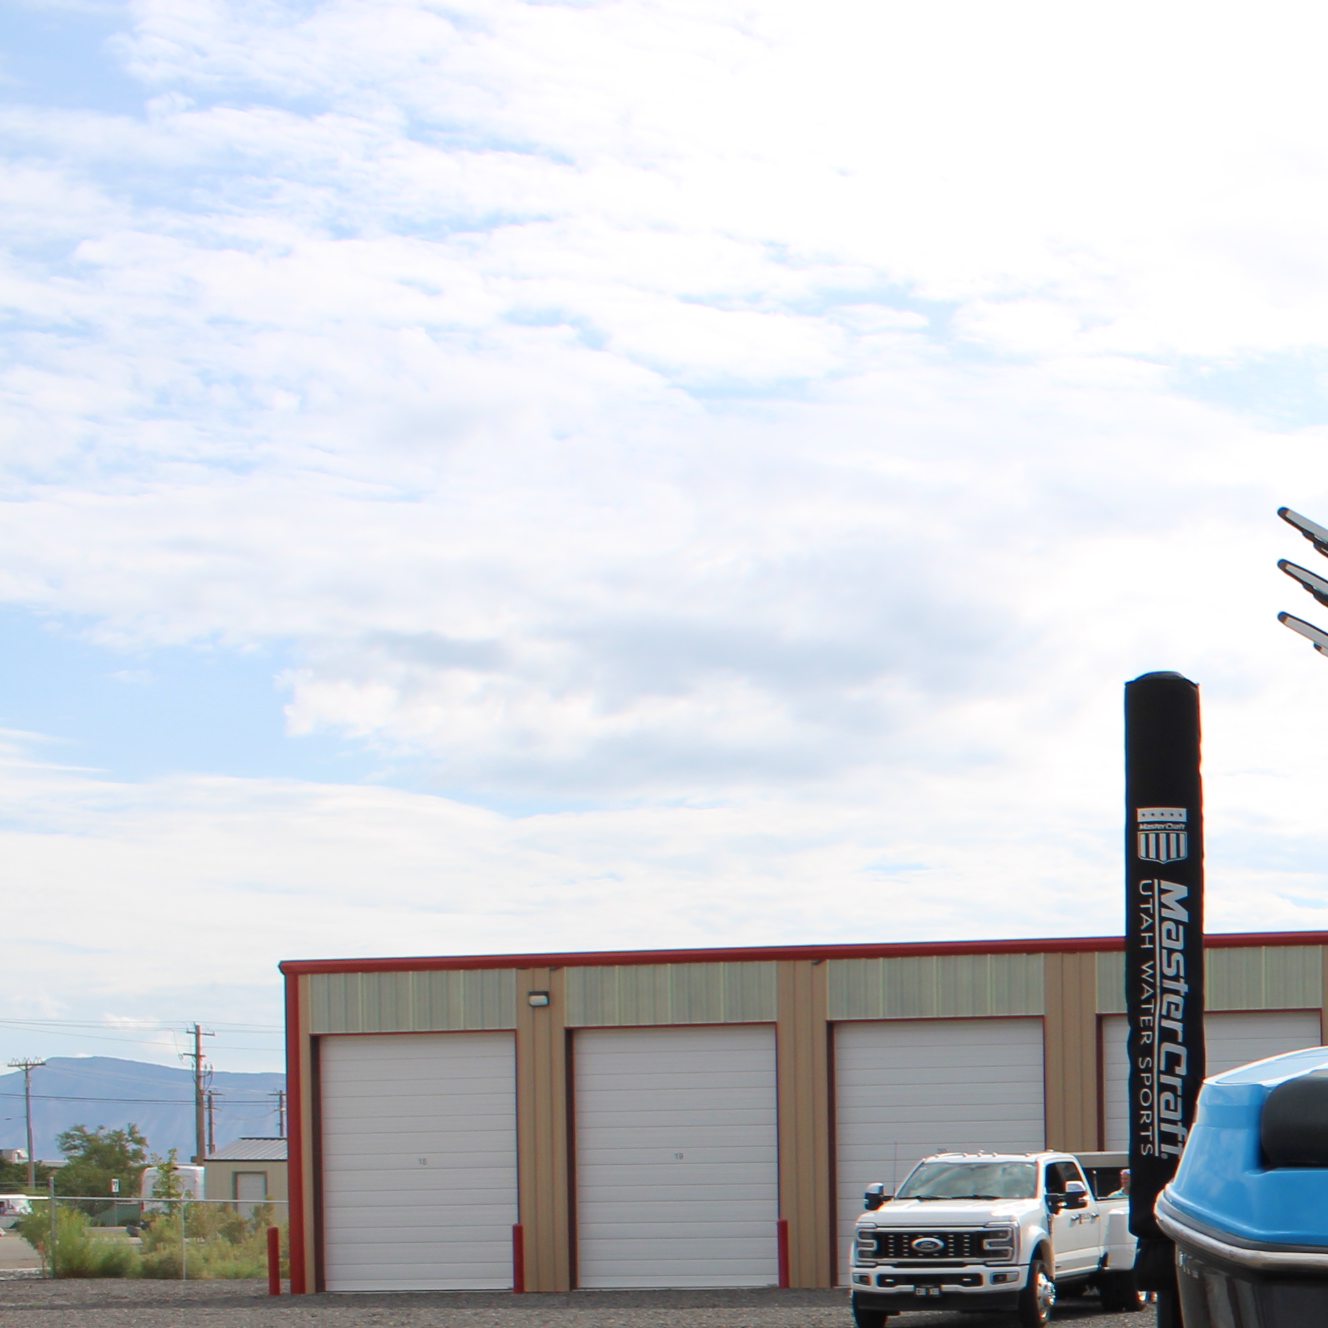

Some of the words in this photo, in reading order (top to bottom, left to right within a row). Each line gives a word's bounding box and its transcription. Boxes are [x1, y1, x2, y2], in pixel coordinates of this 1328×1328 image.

[1139, 880, 1154, 949] UTAH
[1139, 960, 1154, 1046] WATER
[1138, 1057, 1154, 1156] SPORTS
